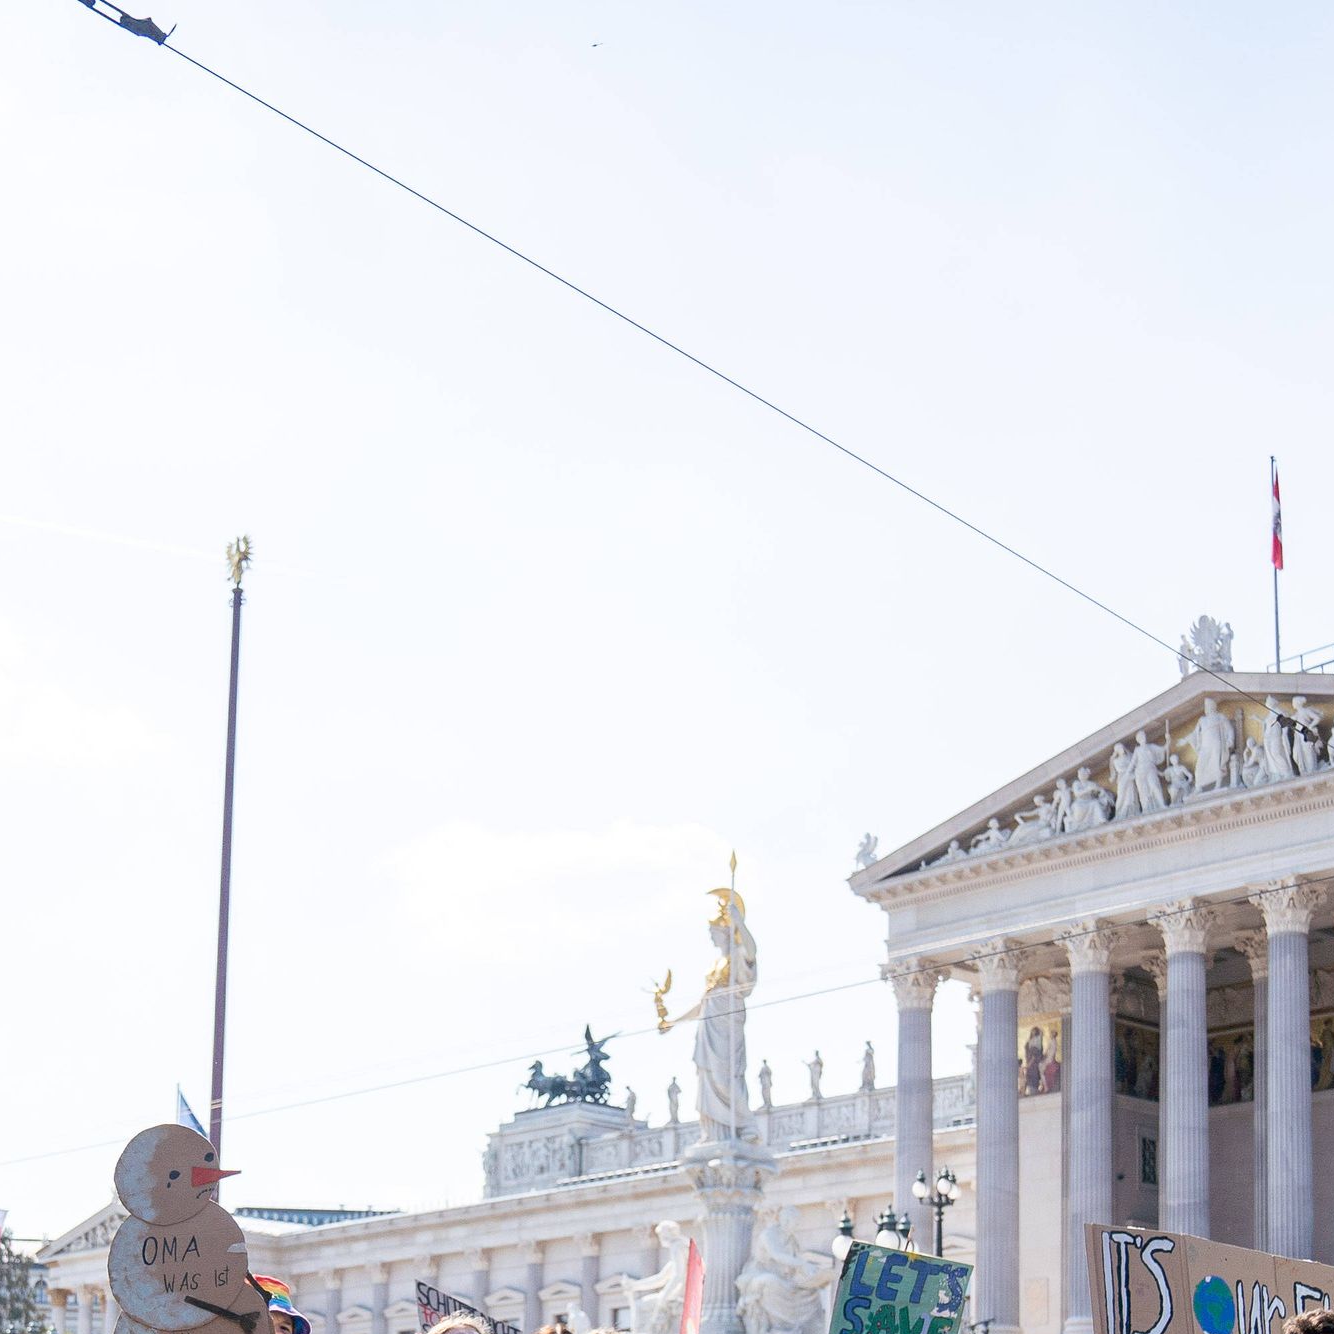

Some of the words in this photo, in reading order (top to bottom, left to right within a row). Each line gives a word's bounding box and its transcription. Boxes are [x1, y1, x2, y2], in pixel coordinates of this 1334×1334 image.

[142, 1235, 201, 1266] OMA
[163, 1272, 202, 1294] WAS
[849, 1251, 969, 1313] LET'S
